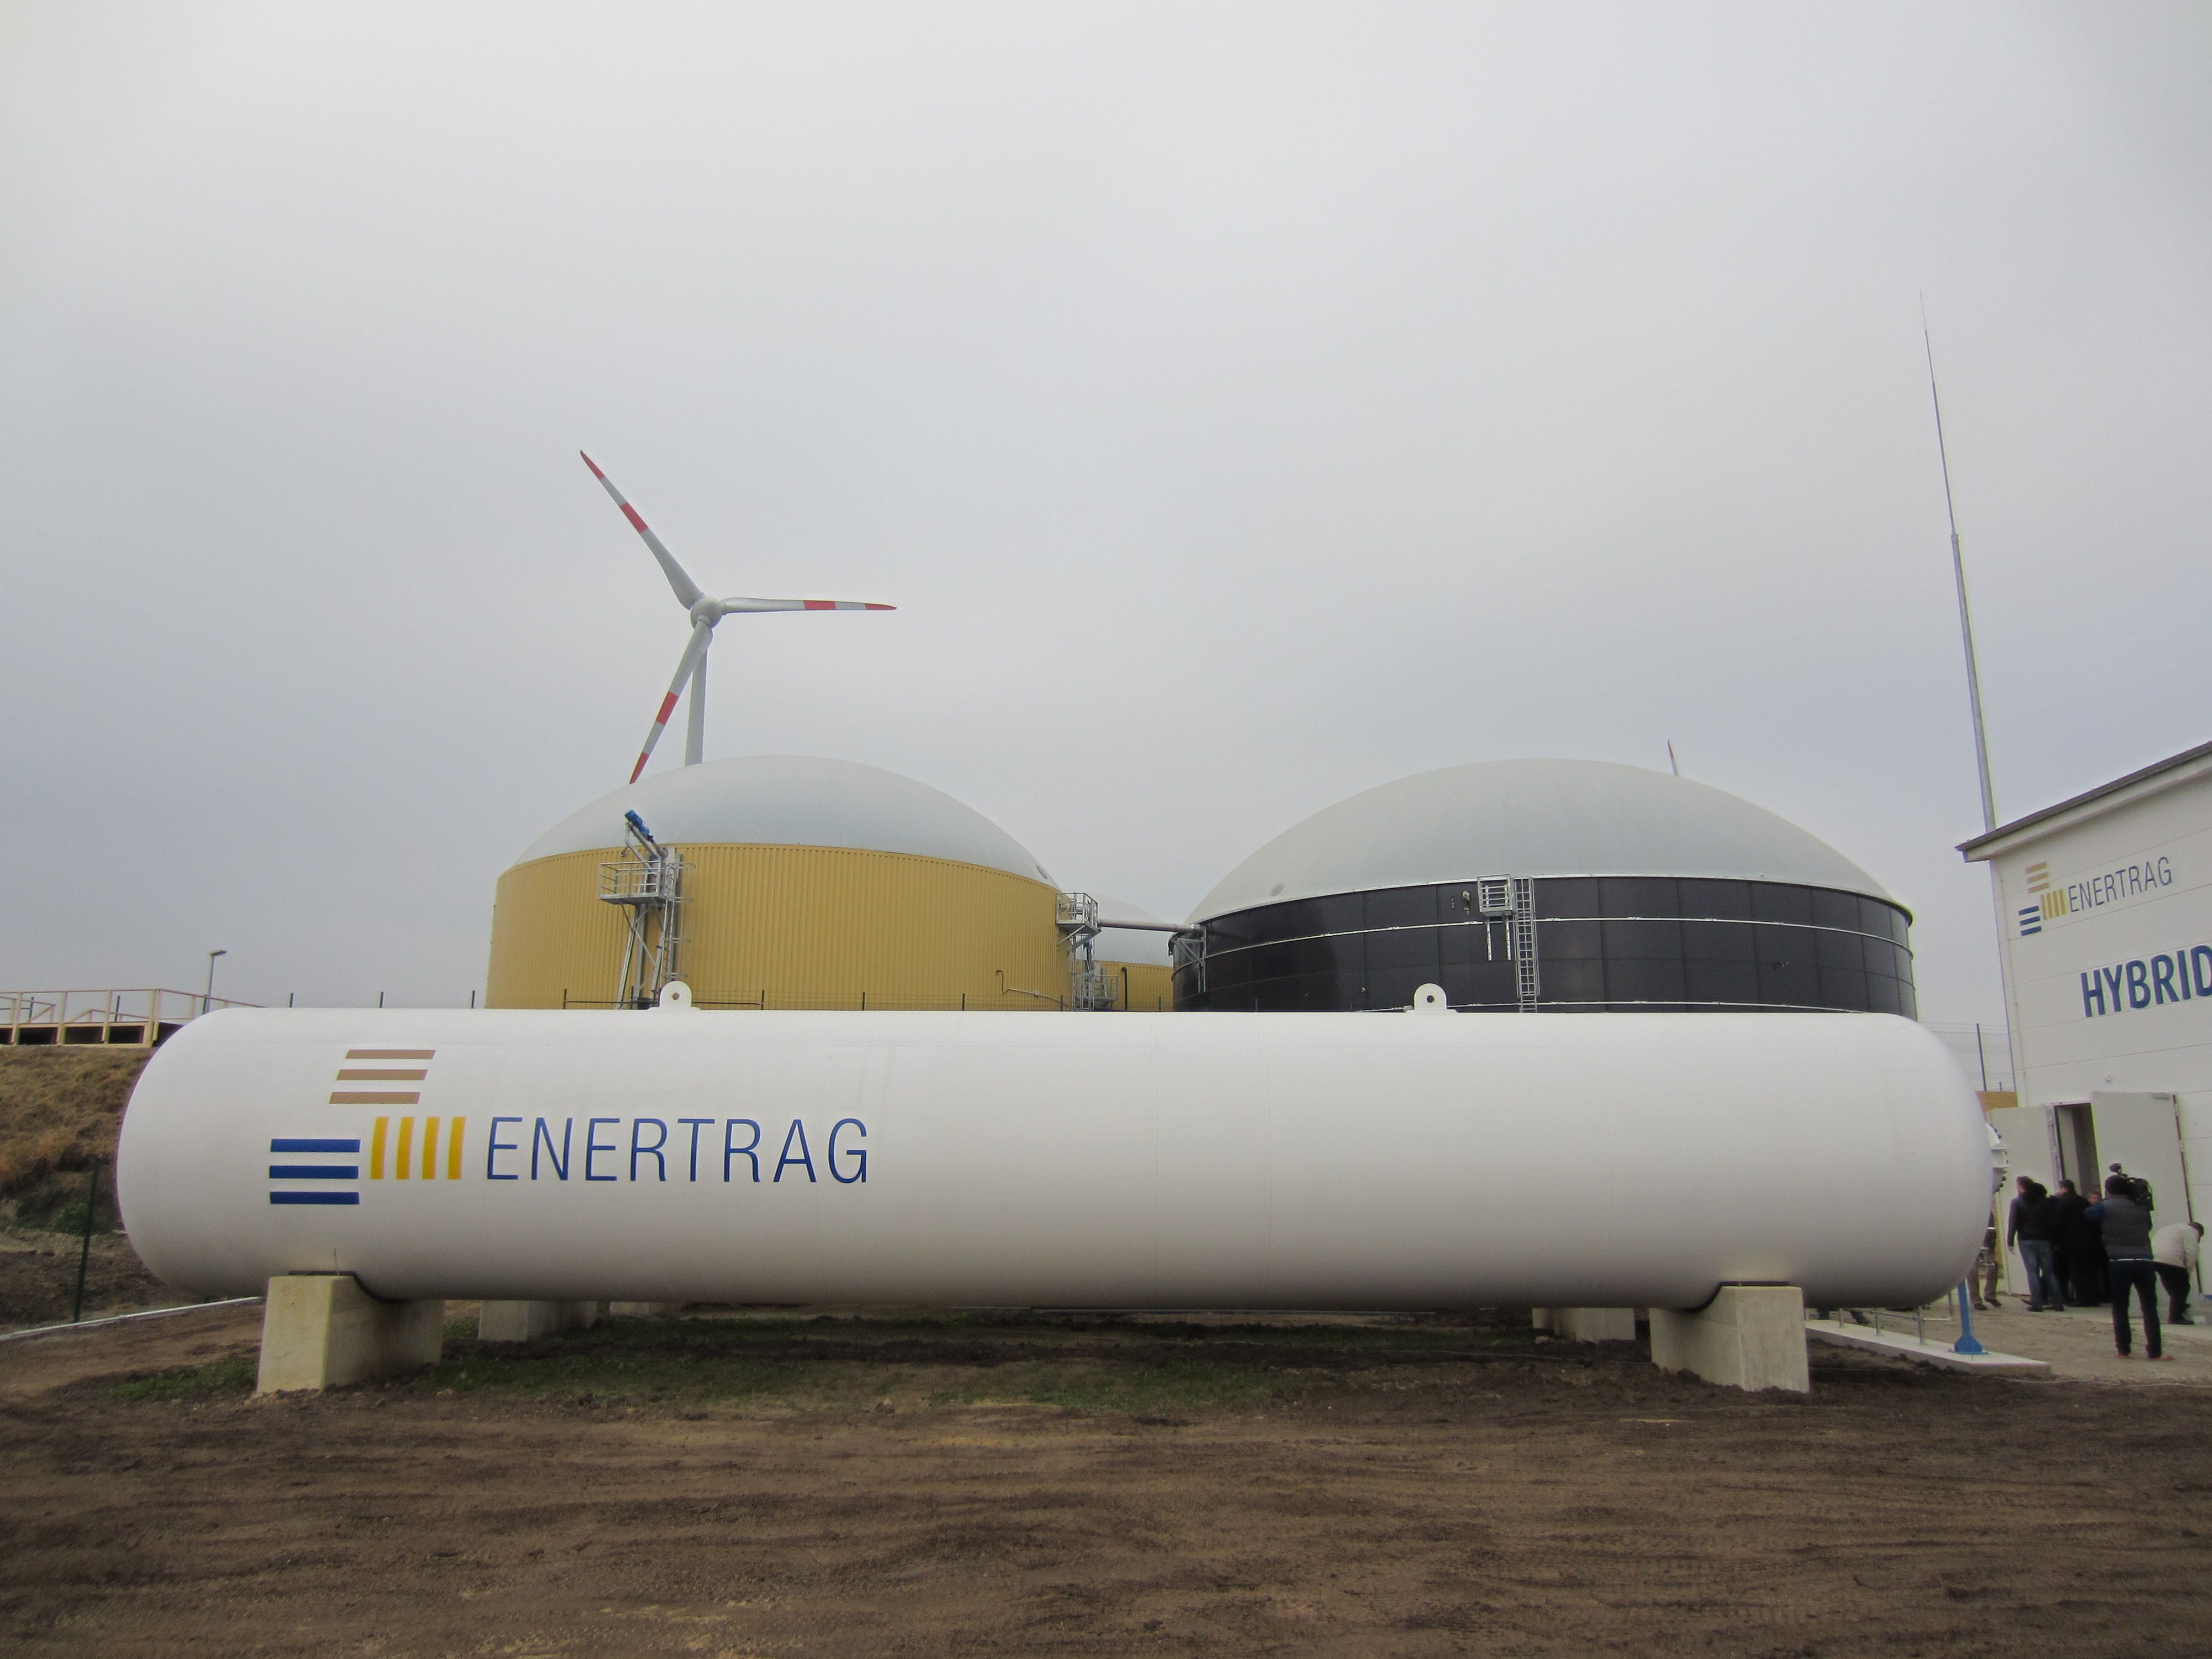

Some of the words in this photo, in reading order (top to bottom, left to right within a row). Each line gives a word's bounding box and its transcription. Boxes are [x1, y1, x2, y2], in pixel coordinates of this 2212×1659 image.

[2068, 857, 2172, 912] ENERTRAG
[2080, 945, 2212, 1017] HYBRID
[487, 1117, 867, 1183] ENERTRAG
